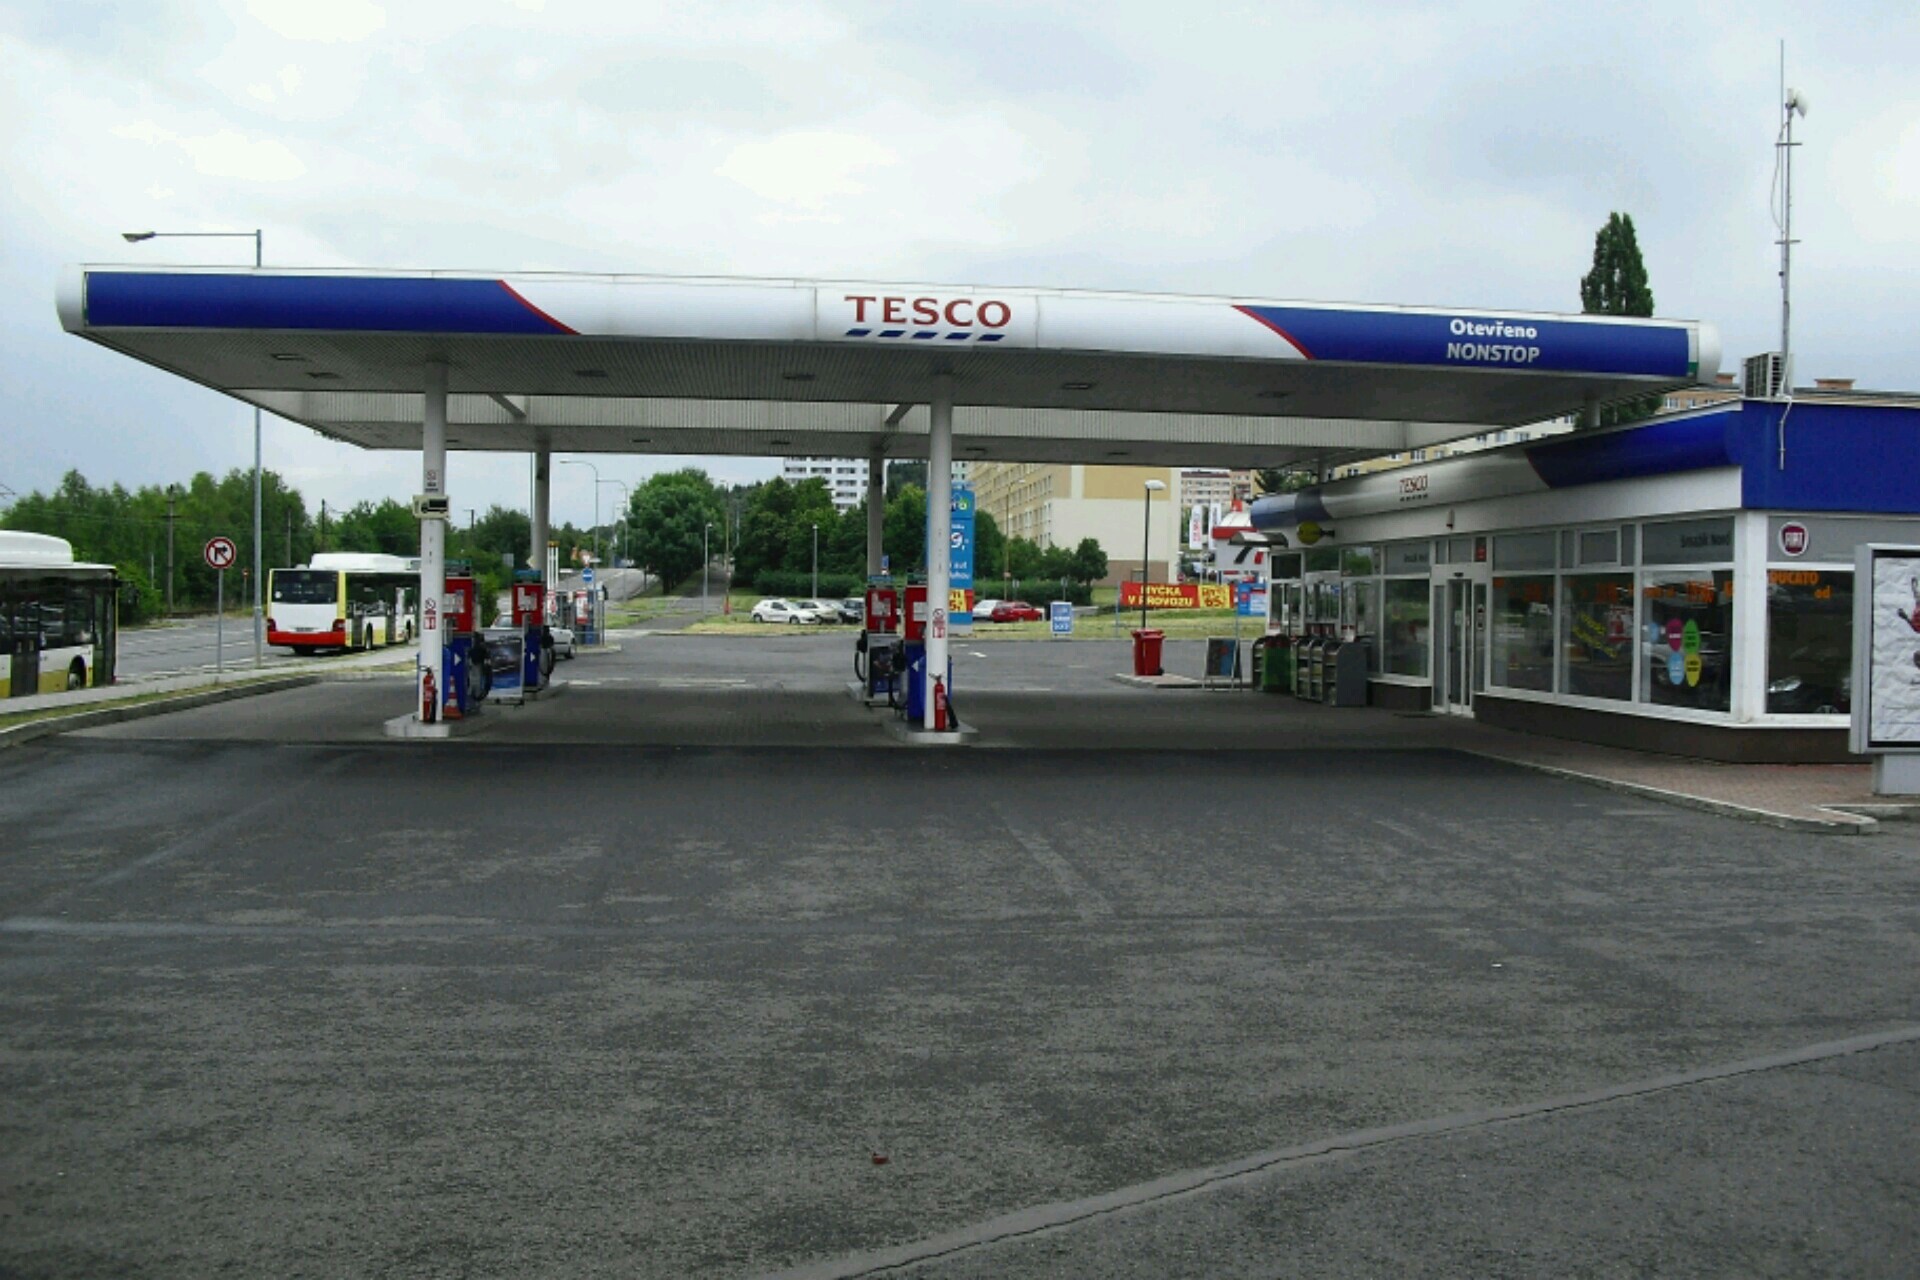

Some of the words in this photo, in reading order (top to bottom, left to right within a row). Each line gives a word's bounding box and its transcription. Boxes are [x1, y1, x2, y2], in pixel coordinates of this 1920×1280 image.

[845, 296, 1011, 328] TESCO
[1450, 319, 1537, 339] Otevřeno
[1447, 343, 1540, 363] NONSTOP
[1400, 475, 1428, 492] TESCO
[1785, 532, 1803, 548] FIAT
[1768, 571, 1819, 585] DUCATO
[1128, 595, 1136, 605] V
